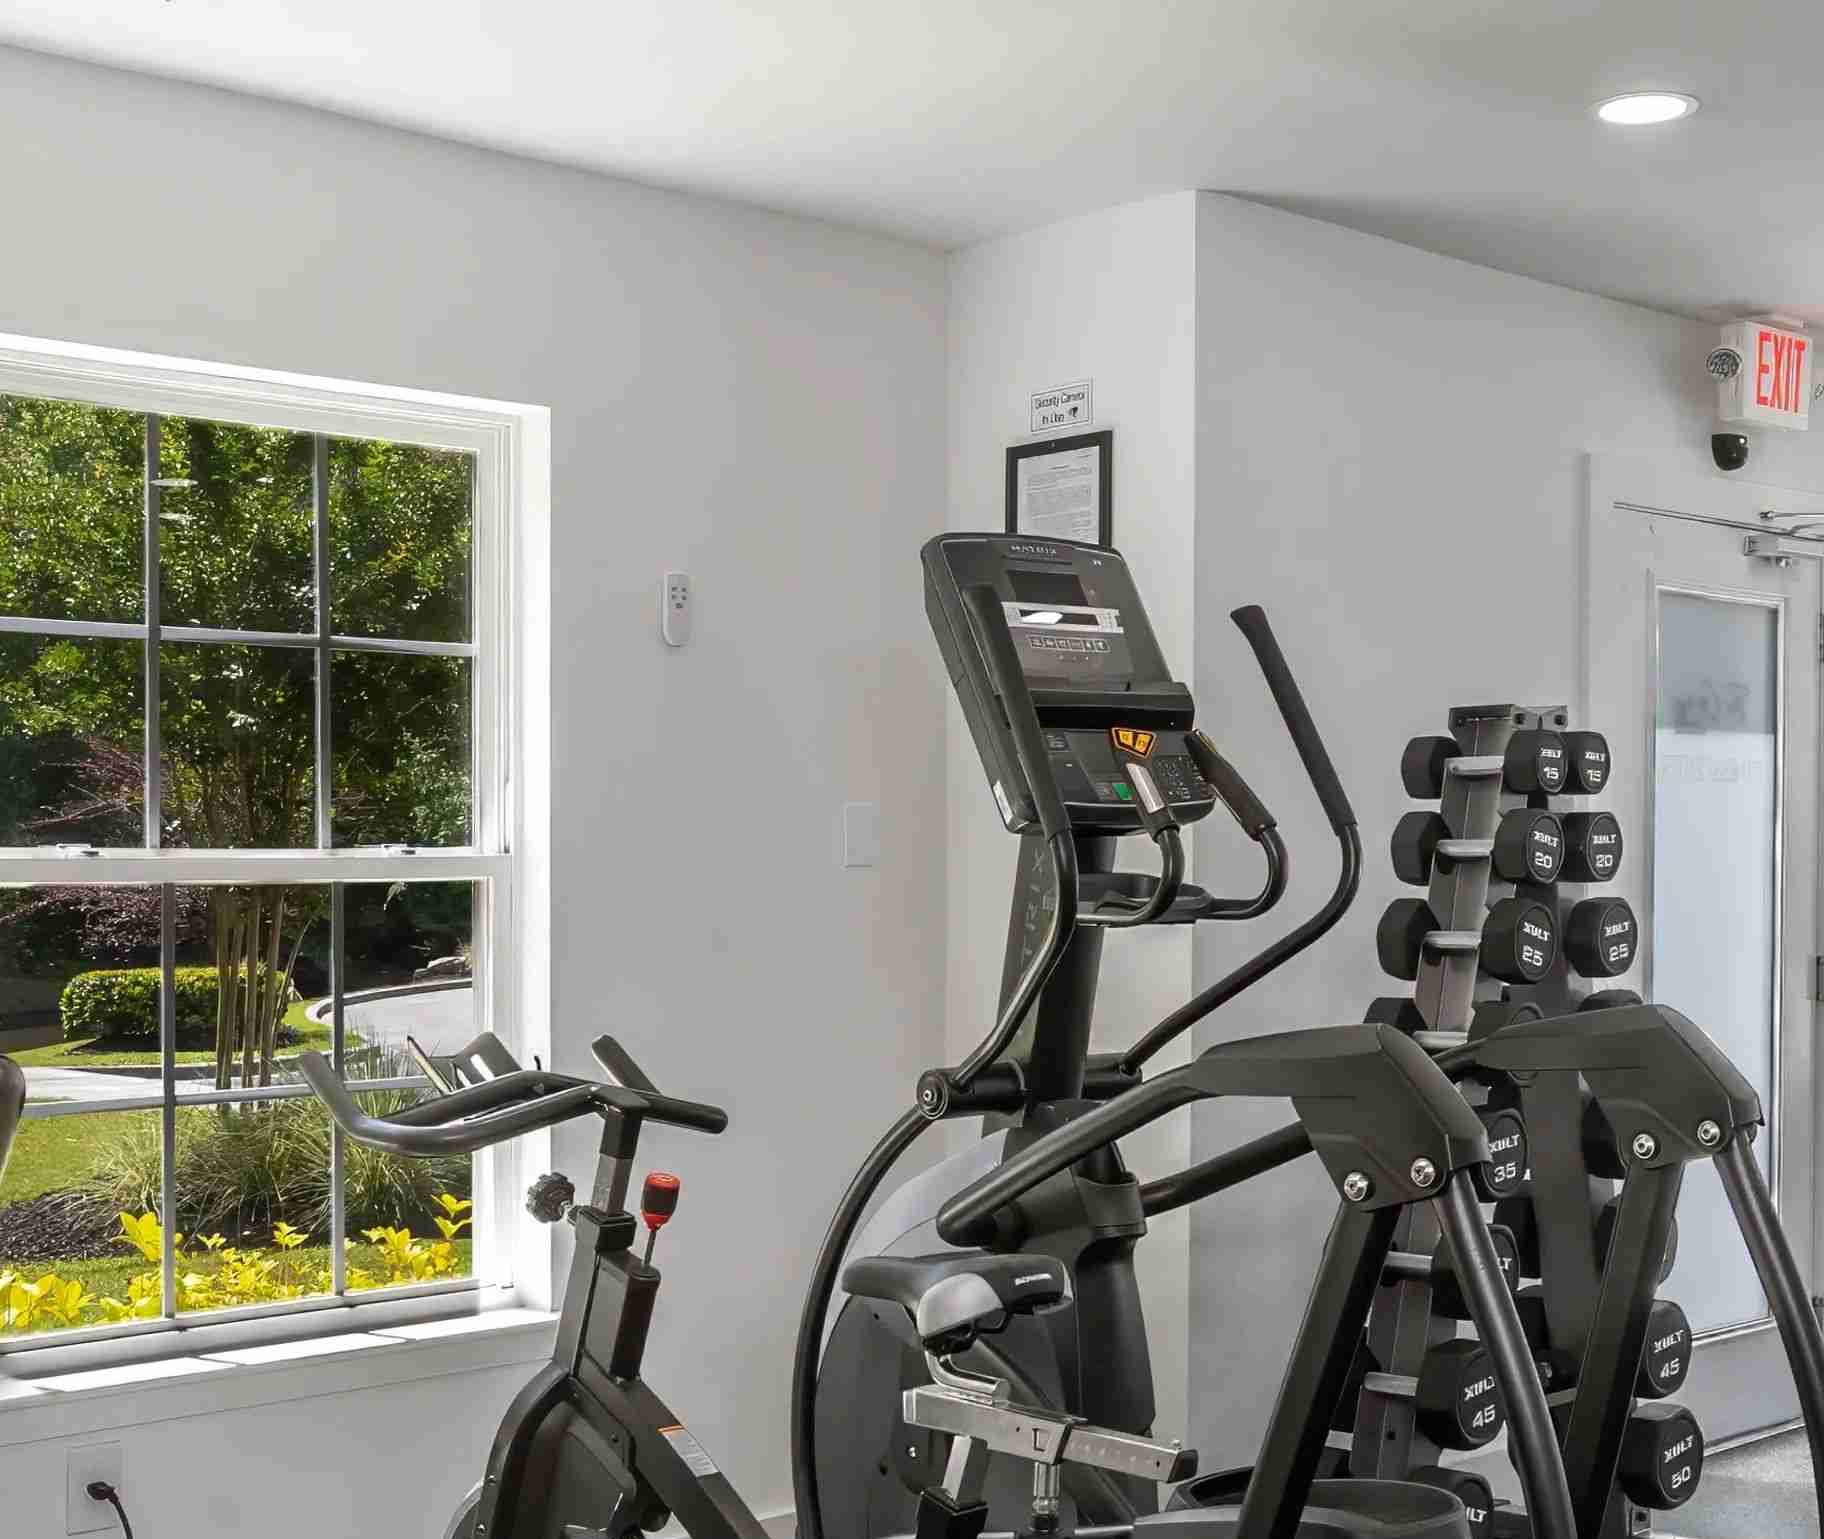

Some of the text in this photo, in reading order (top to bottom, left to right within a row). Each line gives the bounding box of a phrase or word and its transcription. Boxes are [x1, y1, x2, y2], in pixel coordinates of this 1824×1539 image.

[1756, 330, 1805, 413] EXIT
[1543, 766, 1560, 779] 15
[1587, 769, 1601, 782] 15
[1535, 852, 1553, 868] 20
[1595, 854, 1613, 867] 20
[1522, 944, 1544, 967] 25
[1608, 943, 1629, 962] 25
[1494, 1162, 1517, 1183] 35
[1660, 1358, 1680, 1378] 45
[1472, 1404, 1496, 1428] 45
[1664, 1434, 1694, 1463] XULT
[1671, 1466, 1692, 1489] 50
